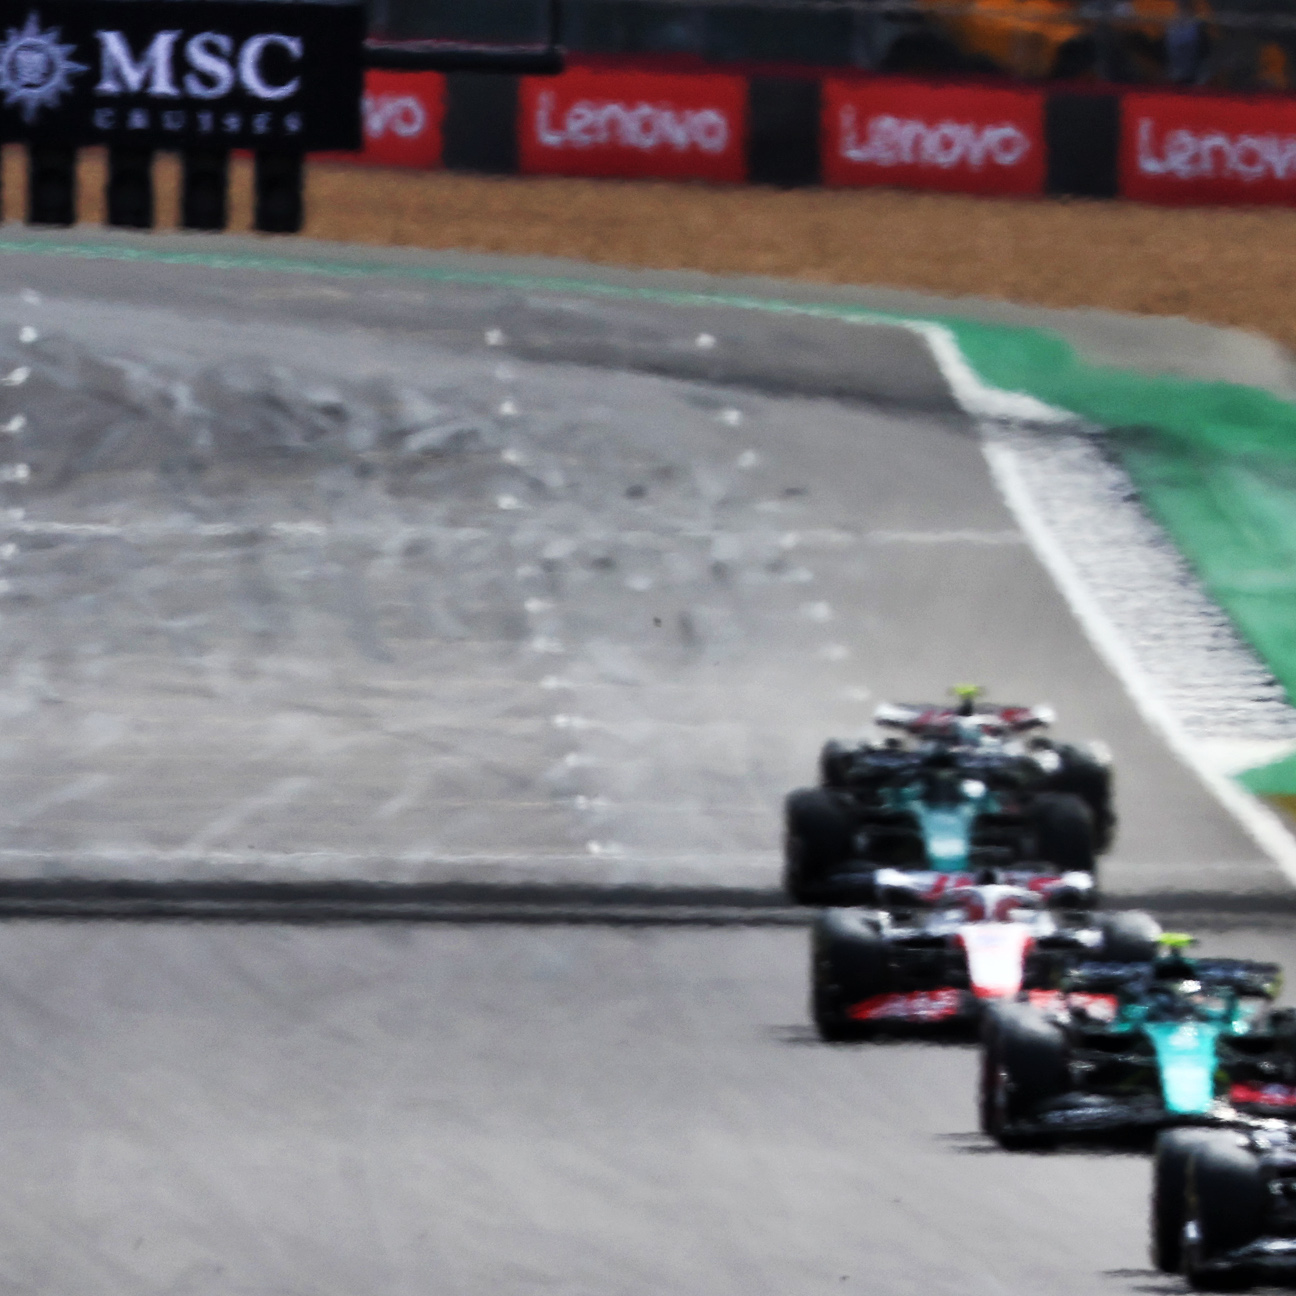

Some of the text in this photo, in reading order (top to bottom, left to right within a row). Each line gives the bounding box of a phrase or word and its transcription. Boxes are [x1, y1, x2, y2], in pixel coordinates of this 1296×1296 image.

[93, 29, 304, 100] MSC
[536, 91, 729, 153] Lenovo
[839, 104, 1030, 169] Lenovo
